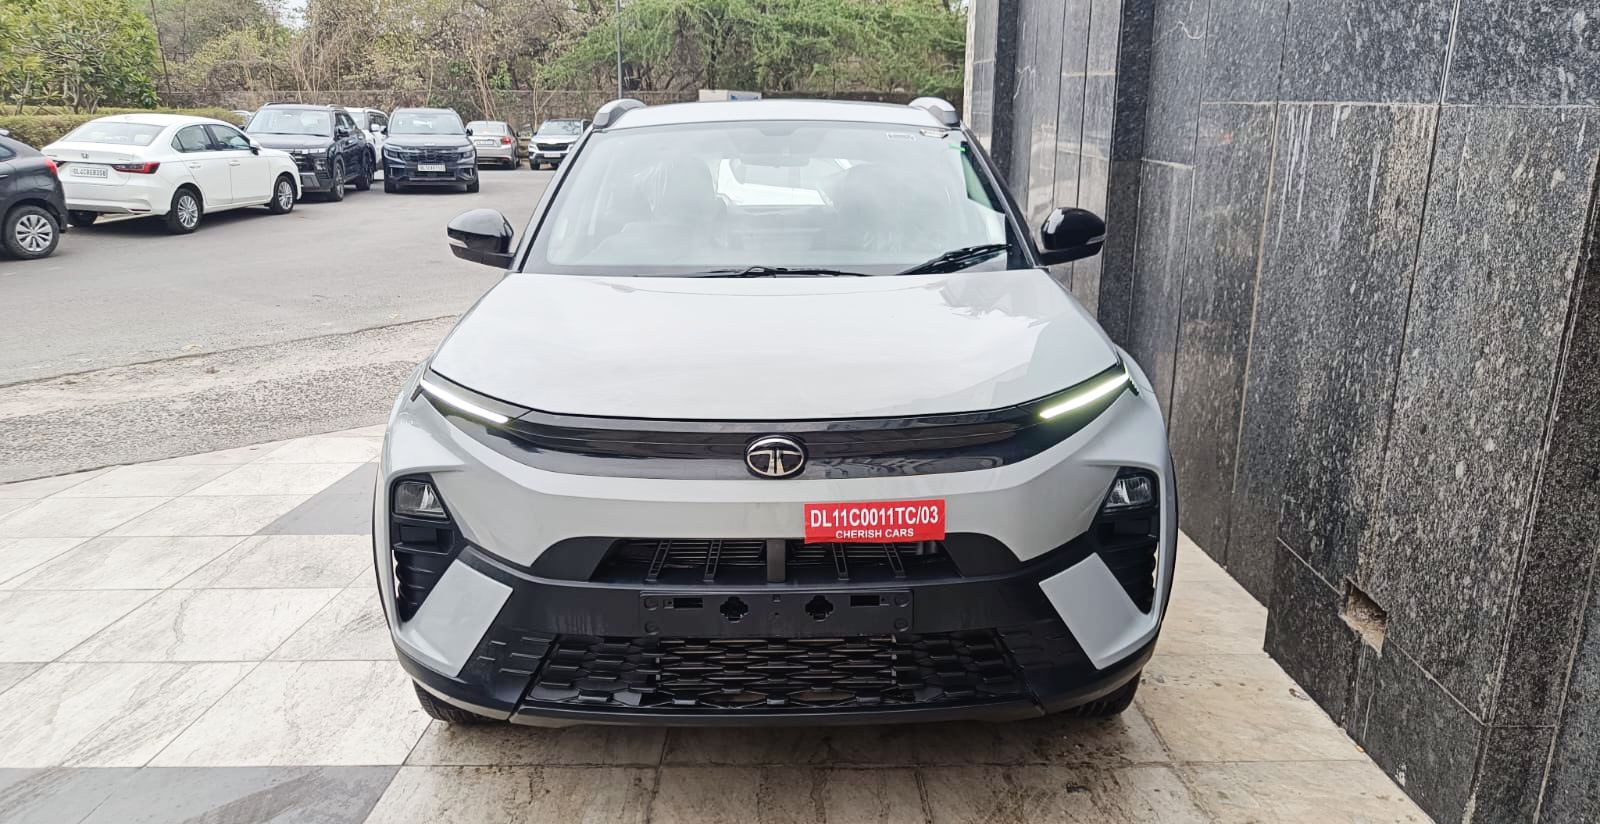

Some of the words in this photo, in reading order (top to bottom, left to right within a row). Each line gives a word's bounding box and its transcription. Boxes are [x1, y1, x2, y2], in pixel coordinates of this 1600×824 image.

[810, 505, 938, 527] DL11C0011TC/03
[835, 529, 882, 539] CHERISH
[885, 528, 914, 538] CARS
